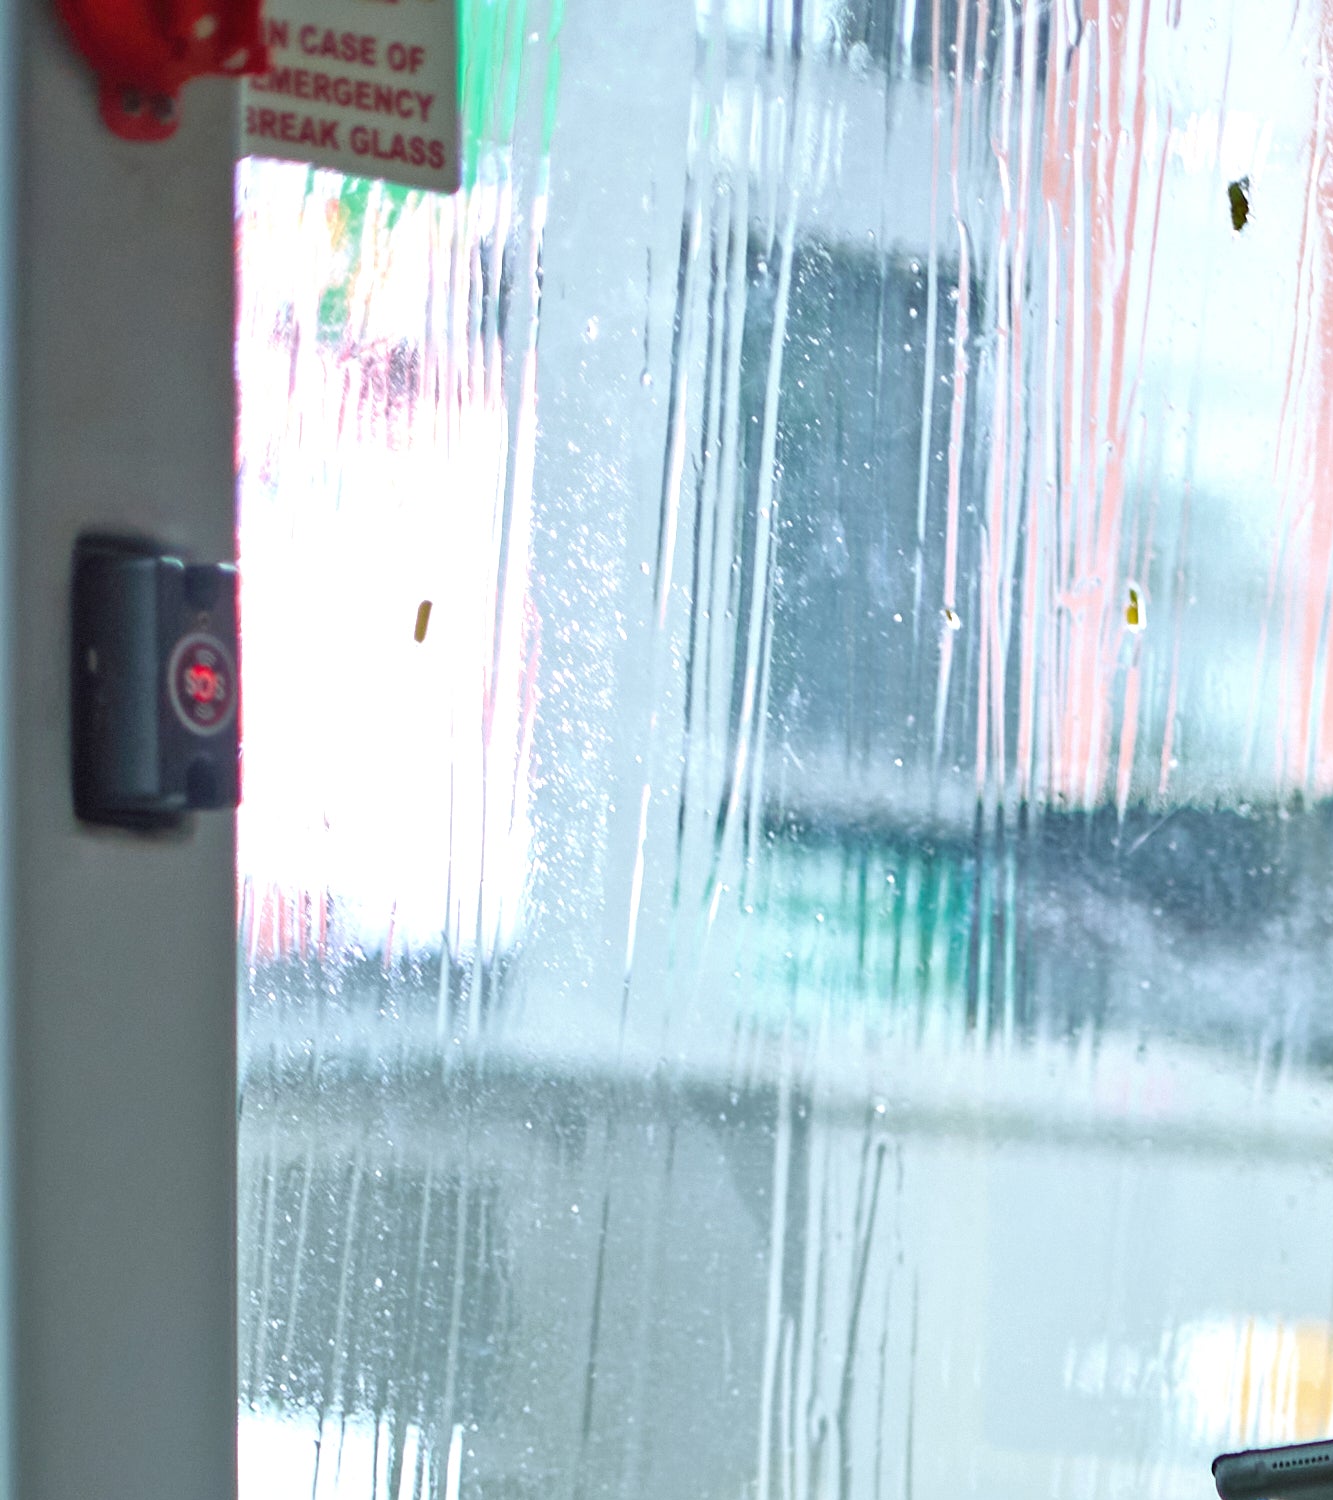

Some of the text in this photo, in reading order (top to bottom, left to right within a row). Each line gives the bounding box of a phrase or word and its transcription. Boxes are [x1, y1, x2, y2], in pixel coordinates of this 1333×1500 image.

[299, 25, 377, 67] CASE
[386, 42, 426, 74] OF
[350, 125, 446, 169] GLASS
[185, 664, 226, 703] SOS
